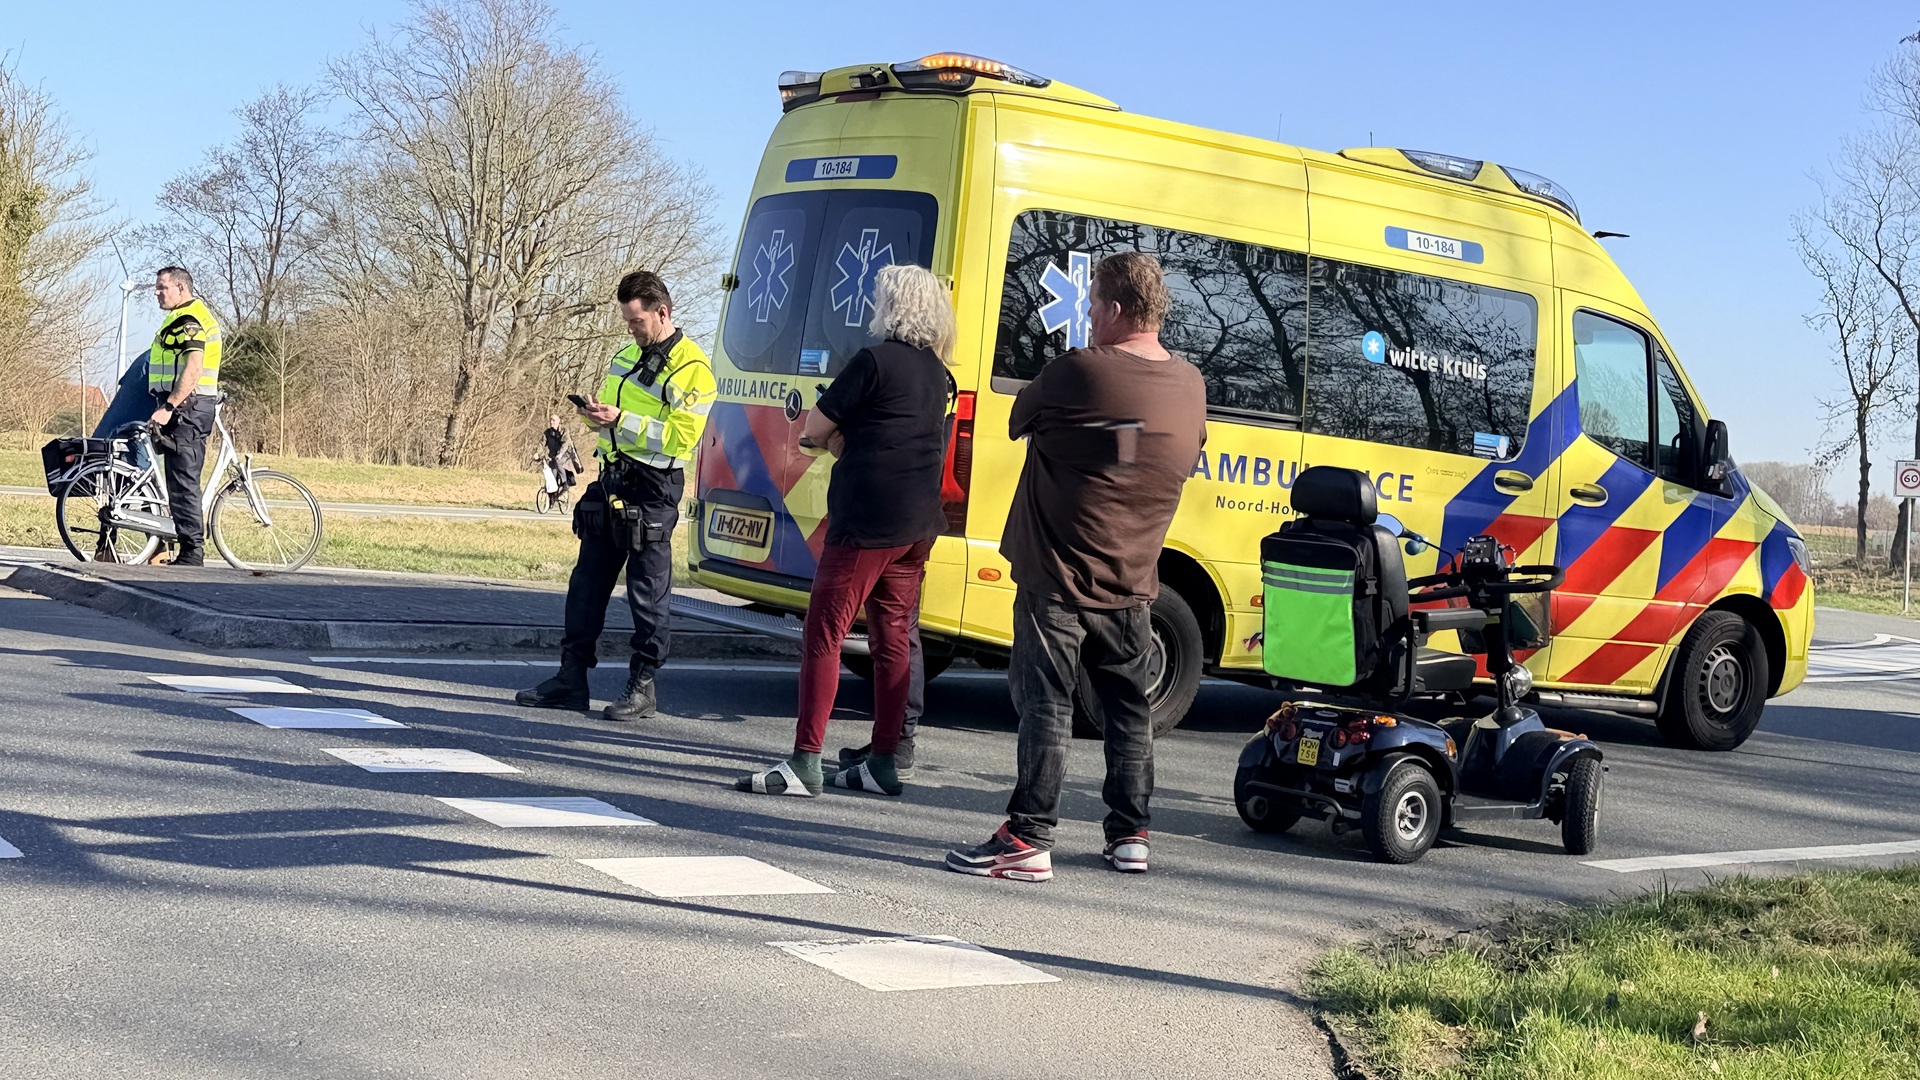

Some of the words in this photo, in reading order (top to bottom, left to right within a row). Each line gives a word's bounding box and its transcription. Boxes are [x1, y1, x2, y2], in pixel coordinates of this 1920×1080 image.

[820, 161, 853, 176] 10-184
[1415, 235, 1456, 256] 10-184
[1389, 346, 1438, 373] witte
[1442, 352, 1488, 381] kruis
[717, 377, 787, 400] MBULANCE
[1189, 450, 1415, 503] AMBUCE
[1903, 474, 1919, 483] 60
[1215, 495, 1300, 516] Noord-Ho
[1300, 748, 1317, 760] 756
